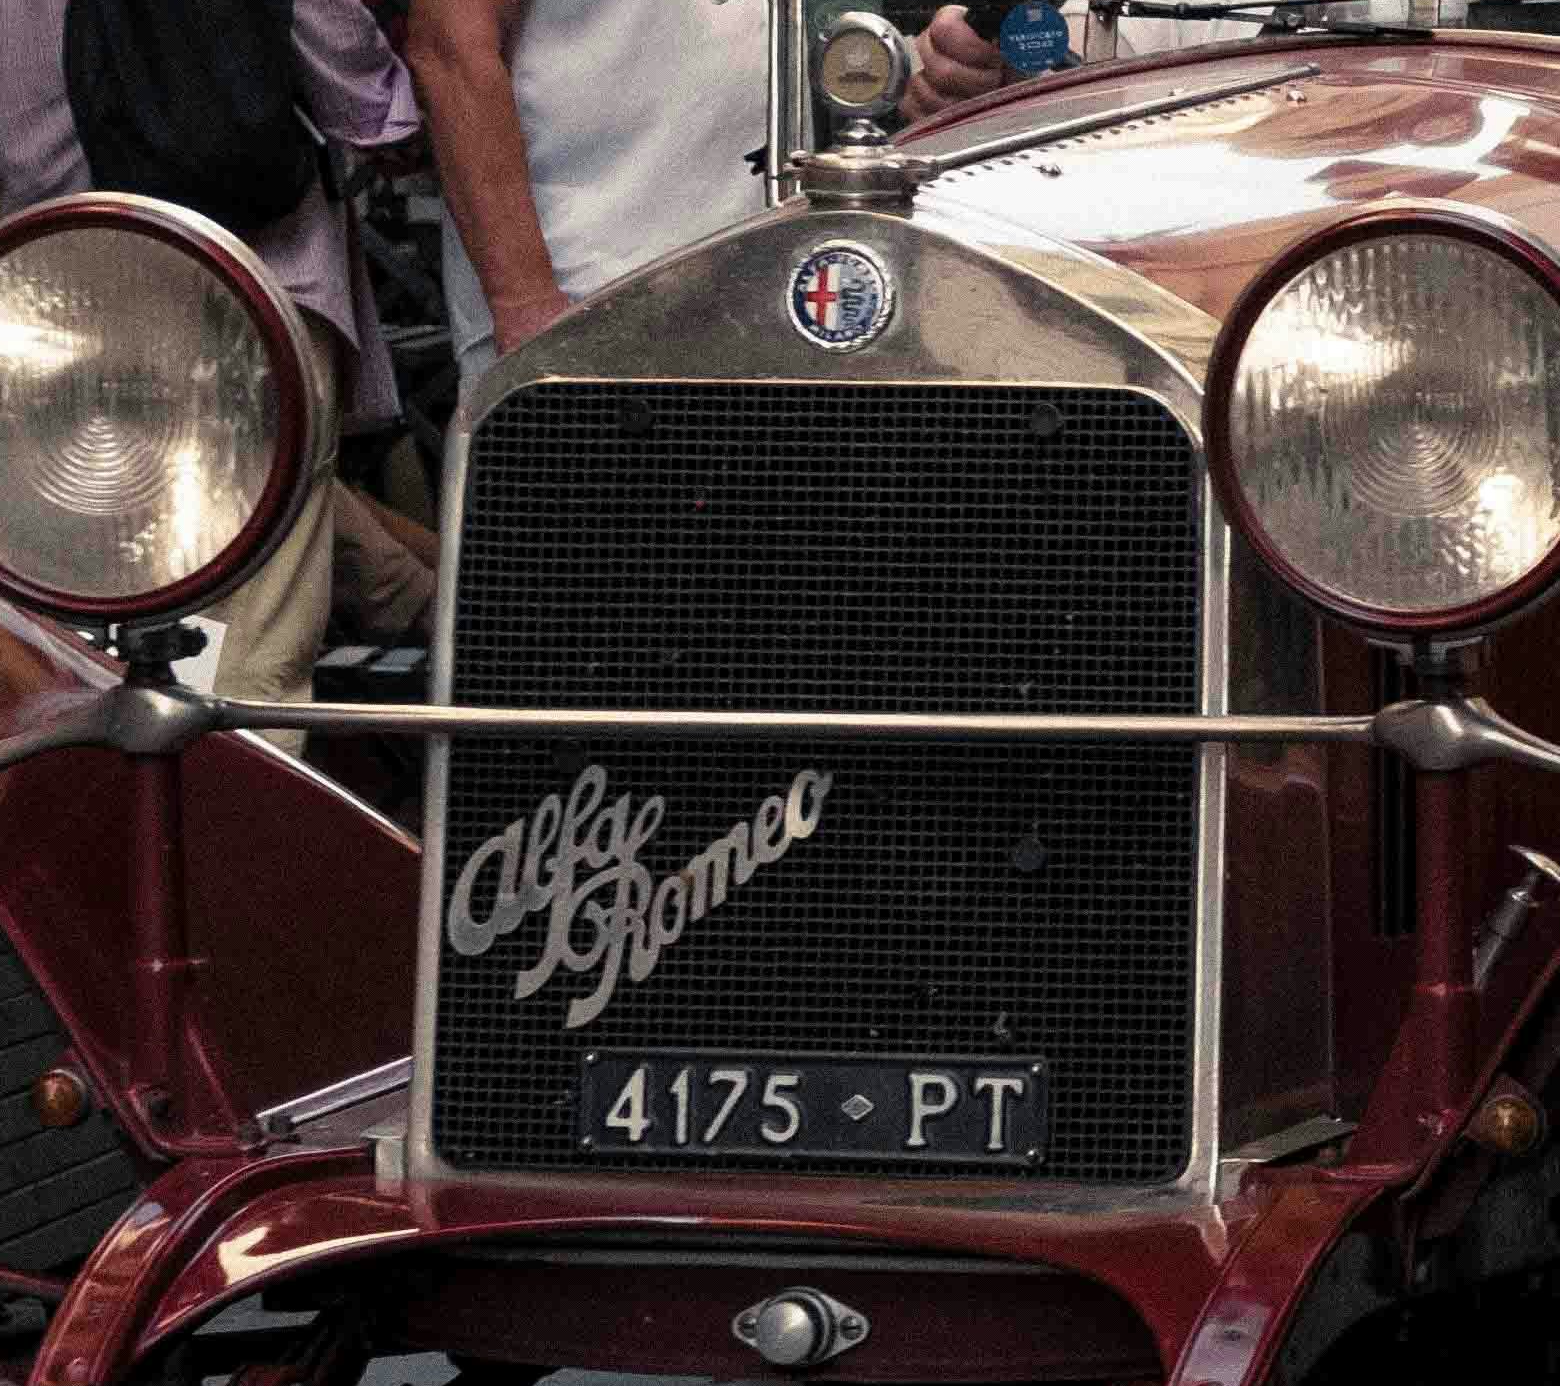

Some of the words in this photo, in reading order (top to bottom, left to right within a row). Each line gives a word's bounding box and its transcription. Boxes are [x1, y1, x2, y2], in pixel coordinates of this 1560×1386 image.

[447, 764, 666, 1000] Alfa
[558, 769, 833, 1030] Romeo
[605, 1067, 803, 1145] 4175
[905, 1071, 1025, 1151] PT
